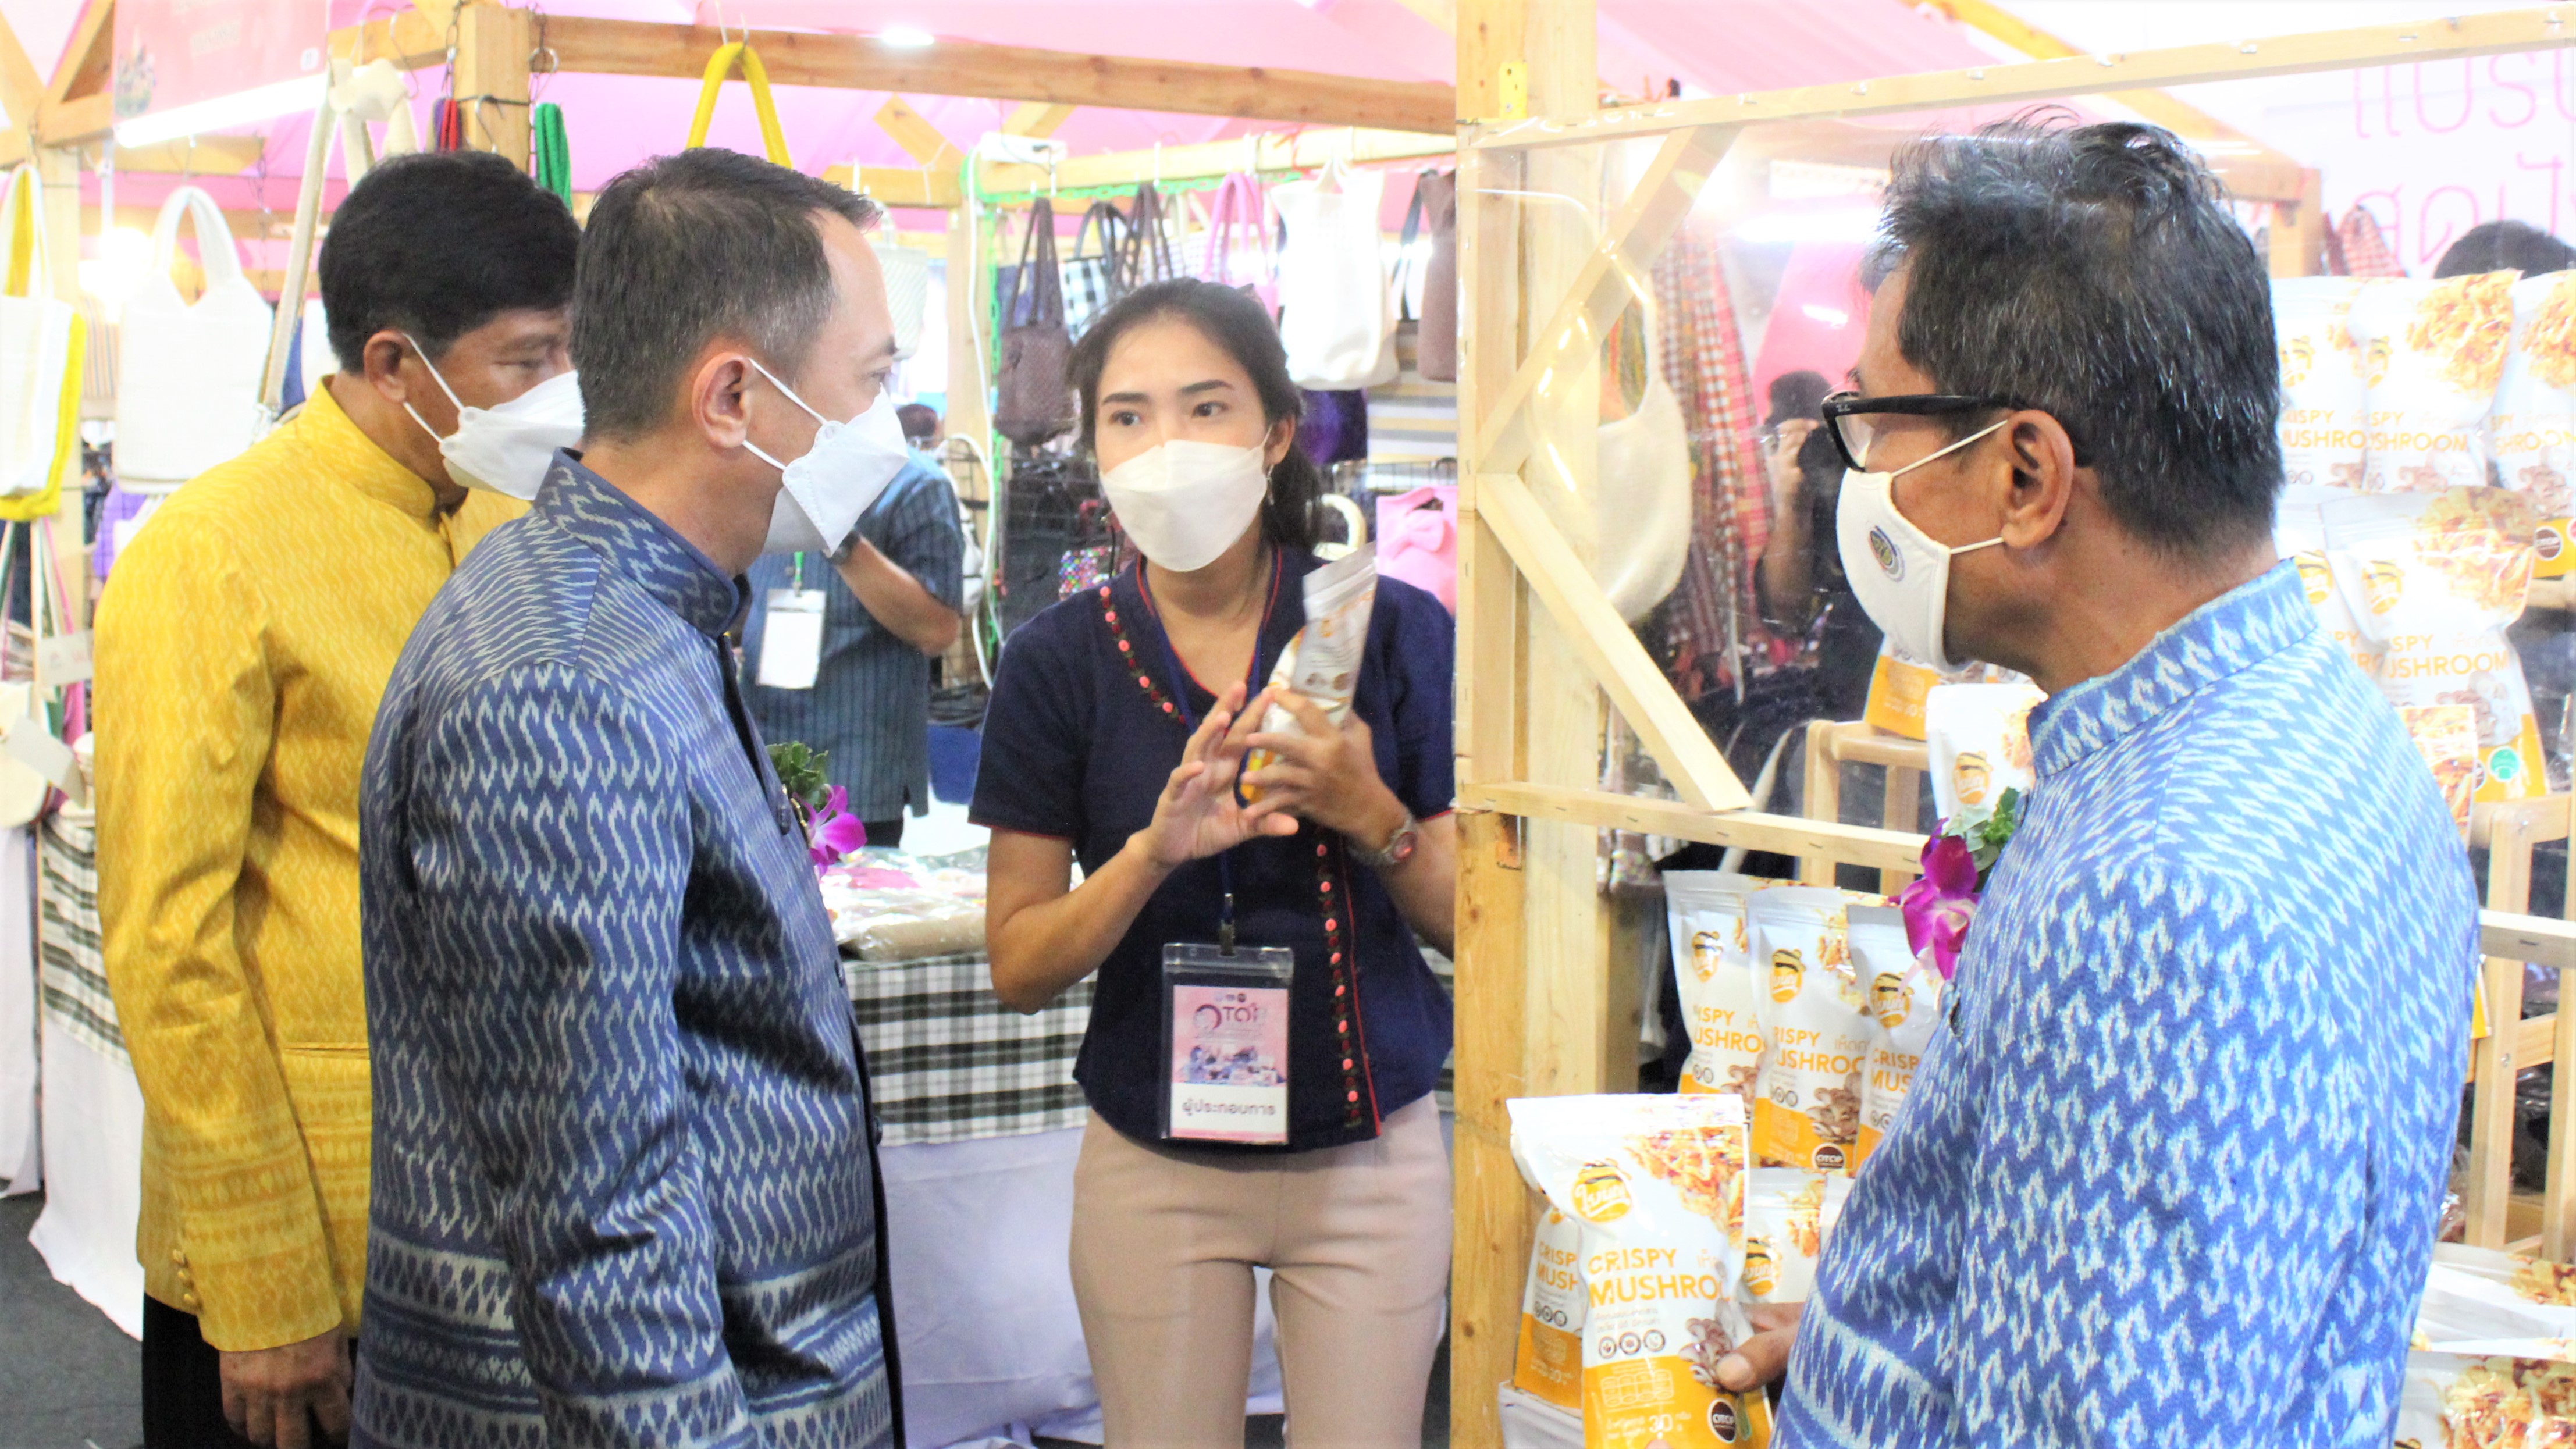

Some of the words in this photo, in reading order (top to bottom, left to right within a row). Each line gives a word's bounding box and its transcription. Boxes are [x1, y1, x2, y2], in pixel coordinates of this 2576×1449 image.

[2283, 429, 2367, 449] MUSHRO
[1693, 1026, 1767, 1053] USHRO
[1872, 1048, 1920, 1070] CRISP
[1538, 1241, 1578, 1267] CRISP
[1588, 1248, 1677, 1275] CRISPY
[1589, 1274, 1730, 1308] MUSHRO
[1648, 1414, 1673, 1433] 30
